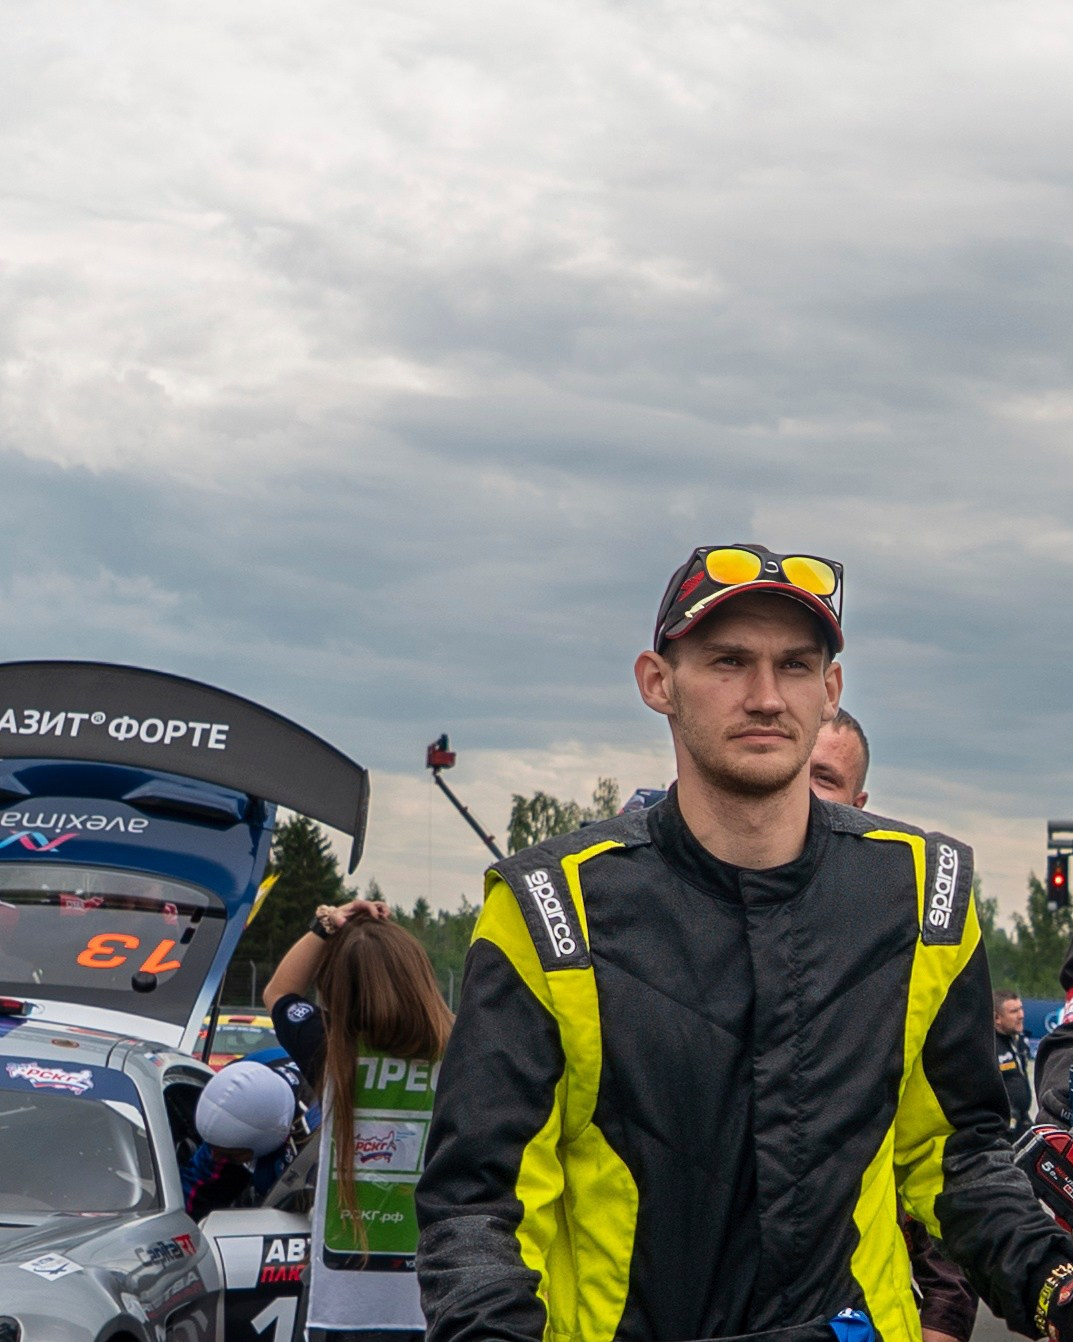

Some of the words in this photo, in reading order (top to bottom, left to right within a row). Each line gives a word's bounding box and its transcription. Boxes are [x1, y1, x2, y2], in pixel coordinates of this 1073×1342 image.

[108, 715, 230, 750] ФОРТЕ
[0, 811, 149, 833] avexima
[929, 844, 958, 928] sparco
[526, 870, 576, 957] sparco
[77, 933, 181, 974] 13
[356, 1057, 438, 1093] ПРЕ
[356, 1142, 387, 1152] РСКГ
[265, 1238, 312, 1263] АВ
